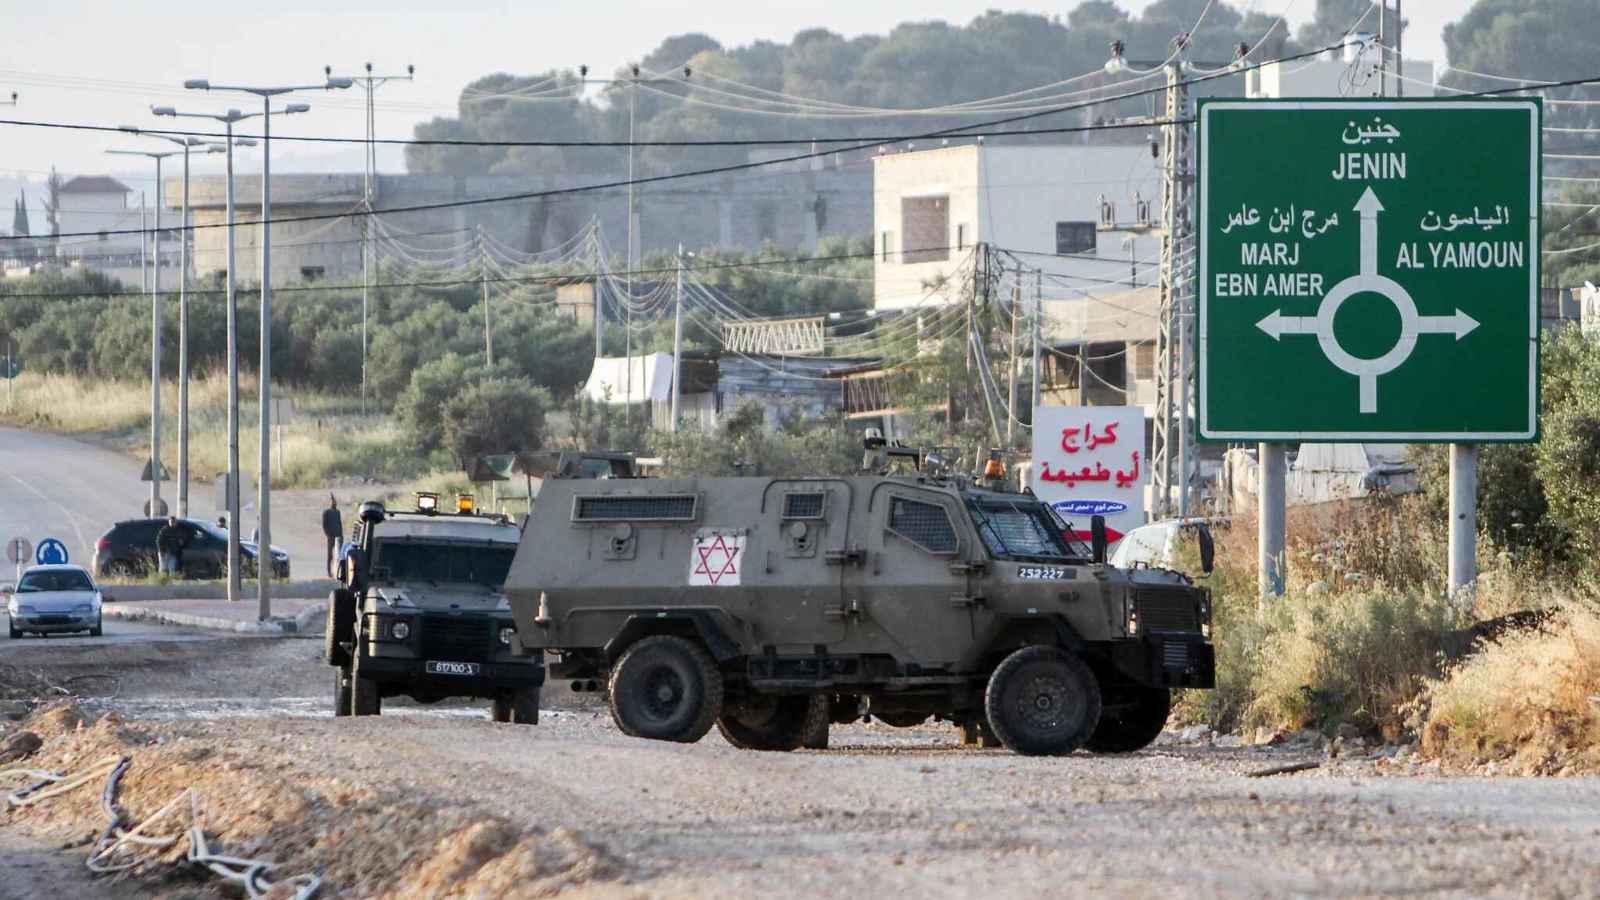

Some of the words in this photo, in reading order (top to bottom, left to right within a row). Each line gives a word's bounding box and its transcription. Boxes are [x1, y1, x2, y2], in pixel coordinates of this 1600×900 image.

[1342, 116, 1401, 145] جنين
[1332, 152, 1406, 180] JENIN
[1220, 203, 1260, 234] عامر
[1268, 203, 1294, 233] ابن
[1301, 209, 1339, 239] مرج
[1241, 242, 1300, 266] MARJ
[1396, 243, 1425, 269] AL
[1428, 241, 1523, 268] YAMOUN
[1215, 273, 1258, 297] EBN
[1263, 273, 1324, 297] AMER
[1061, 421, 1119, 454] كراج
[1040, 461, 1112, 489] طعيمة
[1116, 449, 1139, 489] أبو
